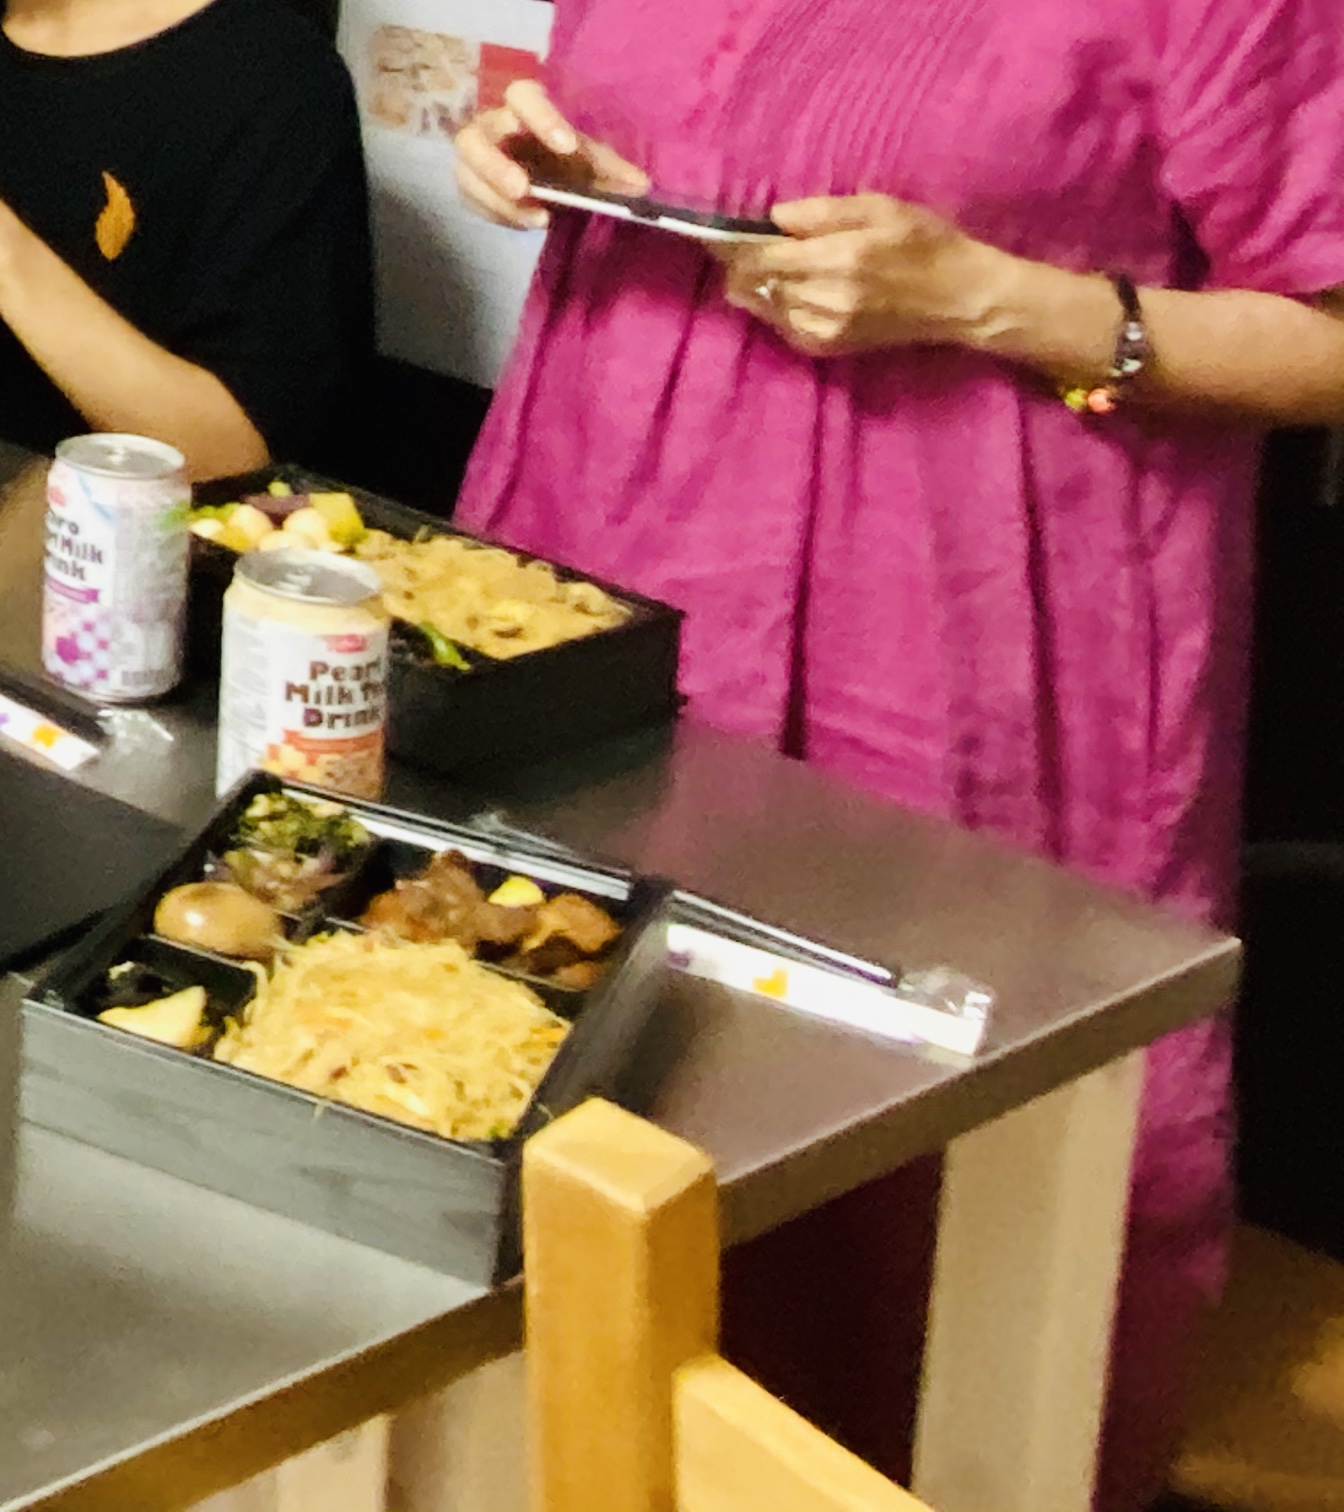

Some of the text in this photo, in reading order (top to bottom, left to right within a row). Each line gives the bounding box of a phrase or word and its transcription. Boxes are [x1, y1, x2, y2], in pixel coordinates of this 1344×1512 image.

[60, 535, 103, 564] Milk
[285, 680, 353, 705] Milk
[302, 706, 381, 730] Drink
